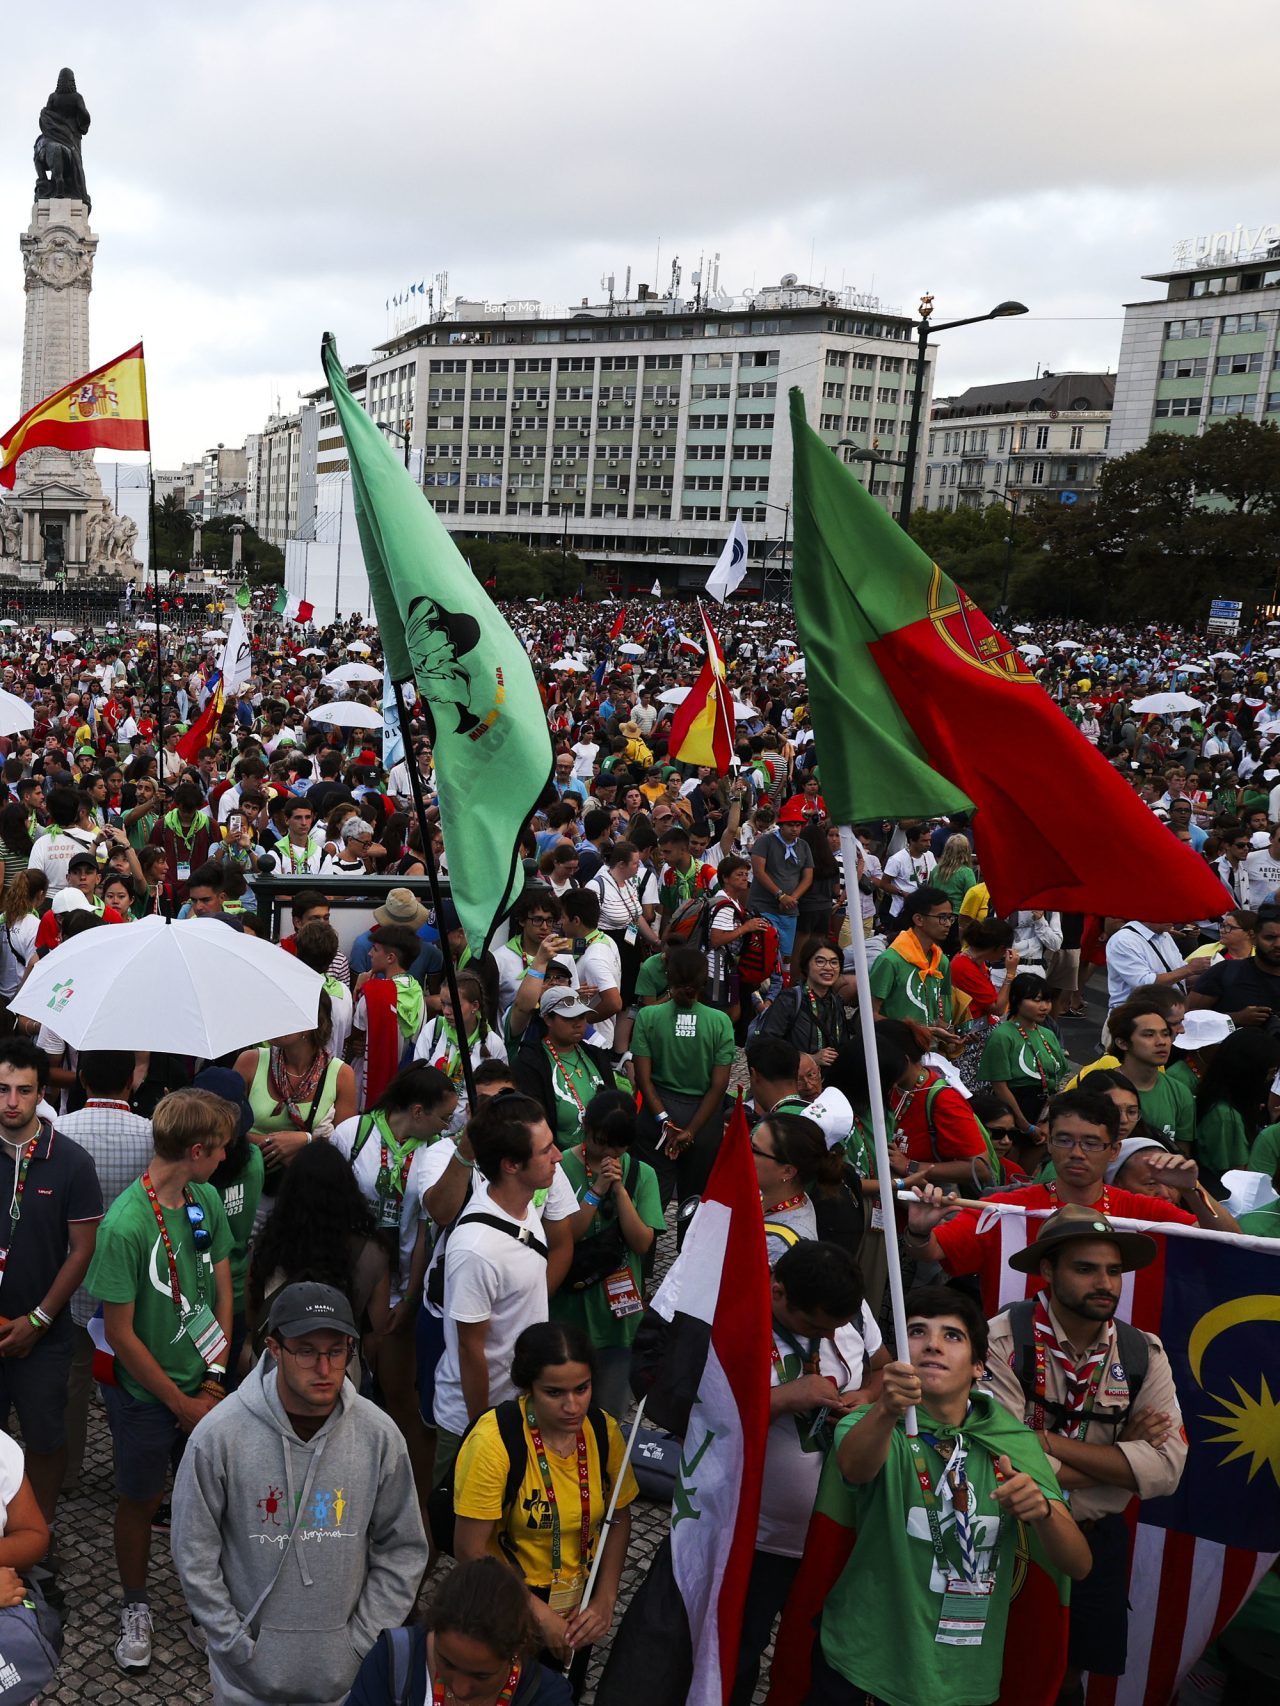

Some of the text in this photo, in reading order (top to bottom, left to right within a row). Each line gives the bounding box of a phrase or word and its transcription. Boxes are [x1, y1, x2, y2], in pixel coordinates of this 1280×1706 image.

[484, 303, 516, 313] Banco
[675, 1014, 697, 1025] JMJ
[224, 1183, 243, 1203] JMJ
[314, 1304, 335, 1312] MARAIS
[926, 1509, 947, 1554] CASCAIS
[4, 1675, 22, 1690] 2023
